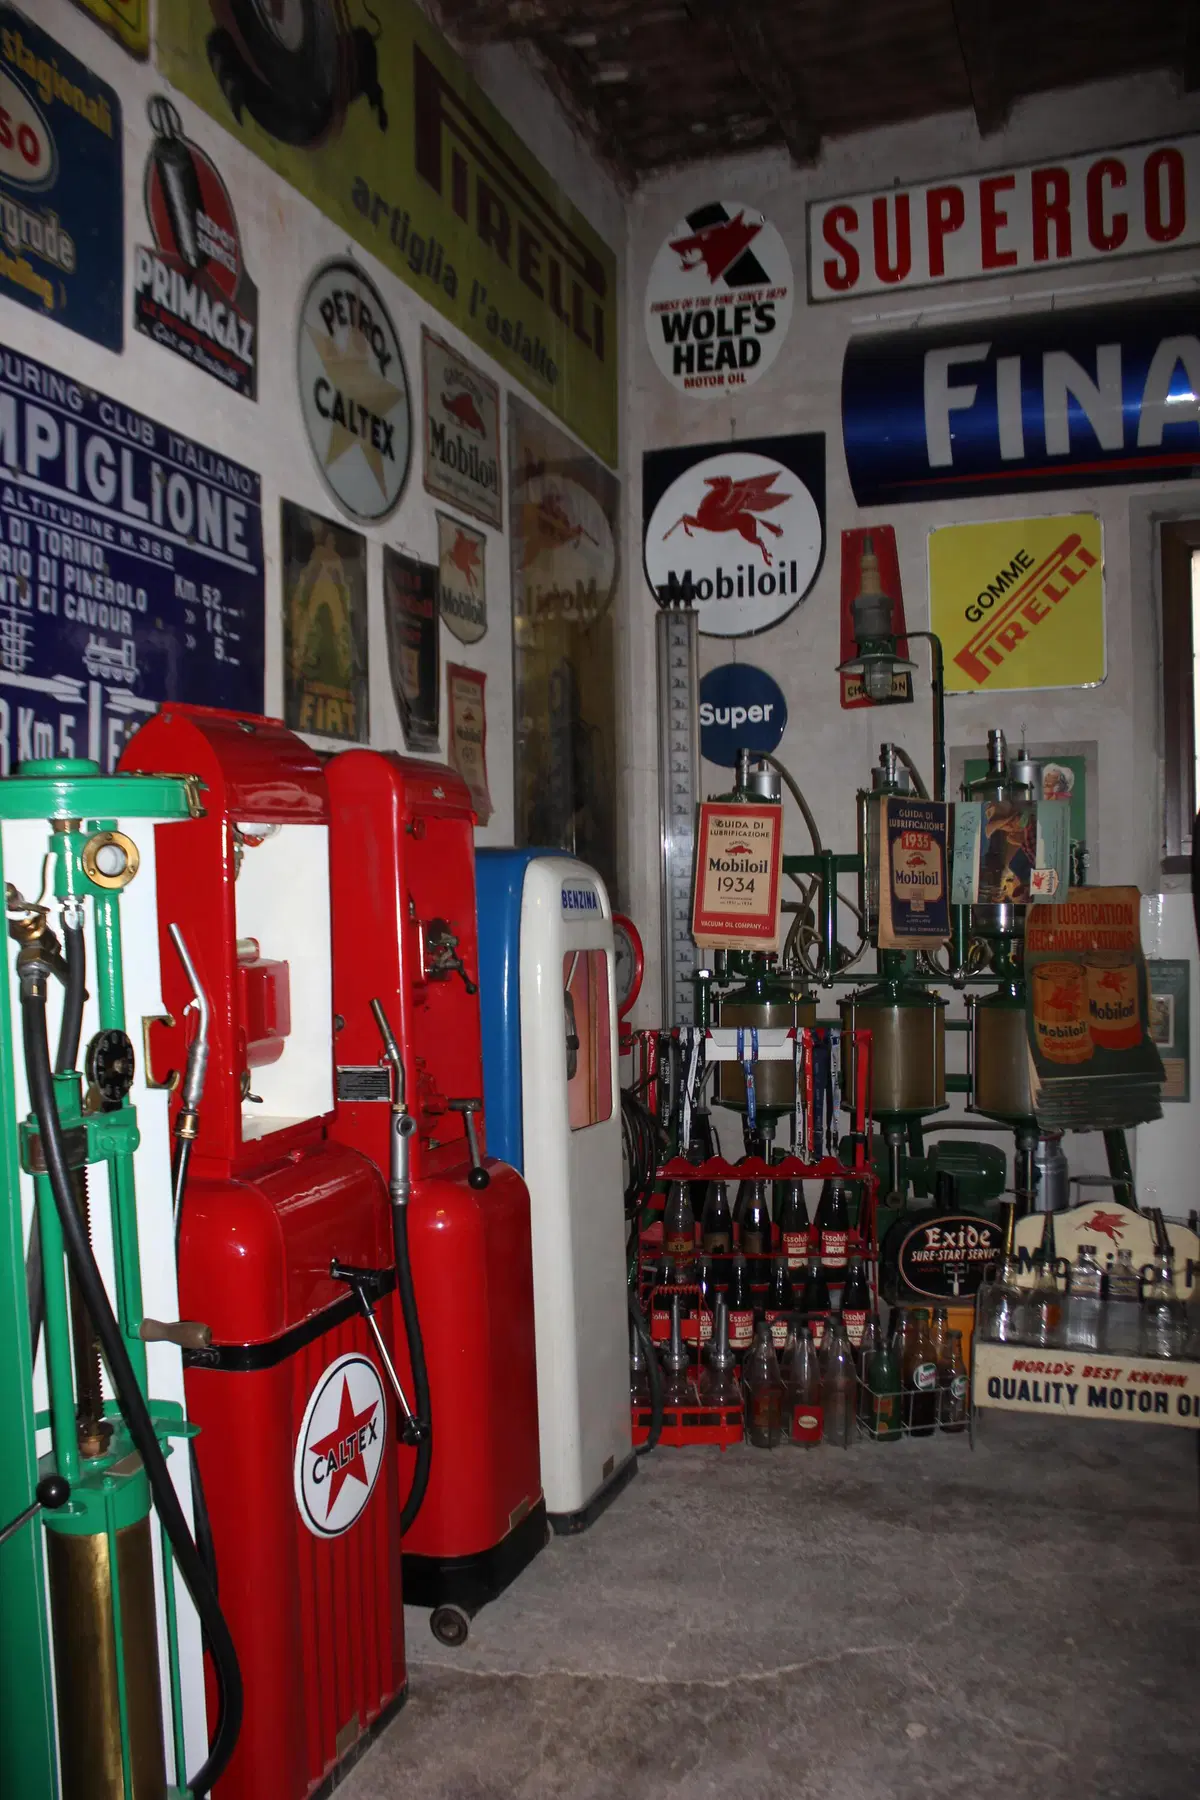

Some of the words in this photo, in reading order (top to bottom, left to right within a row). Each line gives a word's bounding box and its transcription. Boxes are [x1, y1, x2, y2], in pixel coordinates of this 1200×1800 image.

[413, 39, 606, 363] PIRELLI
[822, 148, 1187, 291] SUPERCO
[351, 176, 458, 300] artiglia
[470, 278, 558, 387] l'asfalto
[136, 247, 254, 366] PRIMAGAZ
[661, 301, 776, 343] WOLF'S
[673, 338, 761, 375] HEAD
[684, 375, 724, 389] MOTOR
[728, 372, 746, 384] OIL
[314, 376, 394, 462] CALTEX
[923, 334, 1200, 469] FINA
[98, 400, 156, 448] CLUB
[168, 436, 253, 494] ITALIANO
[430, 416, 498, 497] Mobiloil
[3, 487, 115, 542] ALTITUDINE
[37, 524, 104, 571] TORINO
[38, 554, 58, 587] DI
[64, 561, 148, 614] PINEROLO
[668, 560, 797, 600] Mobiloil
[965, 549, 1036, 622] GOMME
[64, 593, 132, 636] CAVOUR
[953, 532, 1098, 685] PIRELLI
[300, 693, 356, 737] FIAT
[700, 702, 774, 730] Super
[753, 822, 764, 830] DI
[889, 818, 945, 832] LUBRIFICAZIONE
[899, 808, 923, 818] GUIDA
[925, 811, 933, 820] DI
[710, 829, 769, 838] LUBRIFICAZIONE
[904, 832, 929, 849] 1935
[709, 857, 768, 874] Mobiloil
[896, 869, 939, 885] Mobiloil
[562, 889, 597, 910] BENZINA
[717, 877, 755, 893] 1934
[701, 920, 724, 928] VACUUM
[734, 922, 761, 930] COMPANY
[1057, 903, 1133, 926] LUBRICATION
[1089, 997, 1135, 1020] Mobiloil
[1039, 1021, 1087, 1038] Mobiloil
[911, 1247, 966, 1263] SURE-START
[925, 1224, 991, 1250] Exide
[1012, 1359, 1075, 1377] WORLD'S
[1082, 1365, 1122, 1382] BEST
[1127, 1370, 1188, 1388] KNOWN
[988, 1376, 1079, 1406] QUALITY
[1088, 1385, 1169, 1415] MOTOR
[312, 1417, 377, 1485] CALTEX
